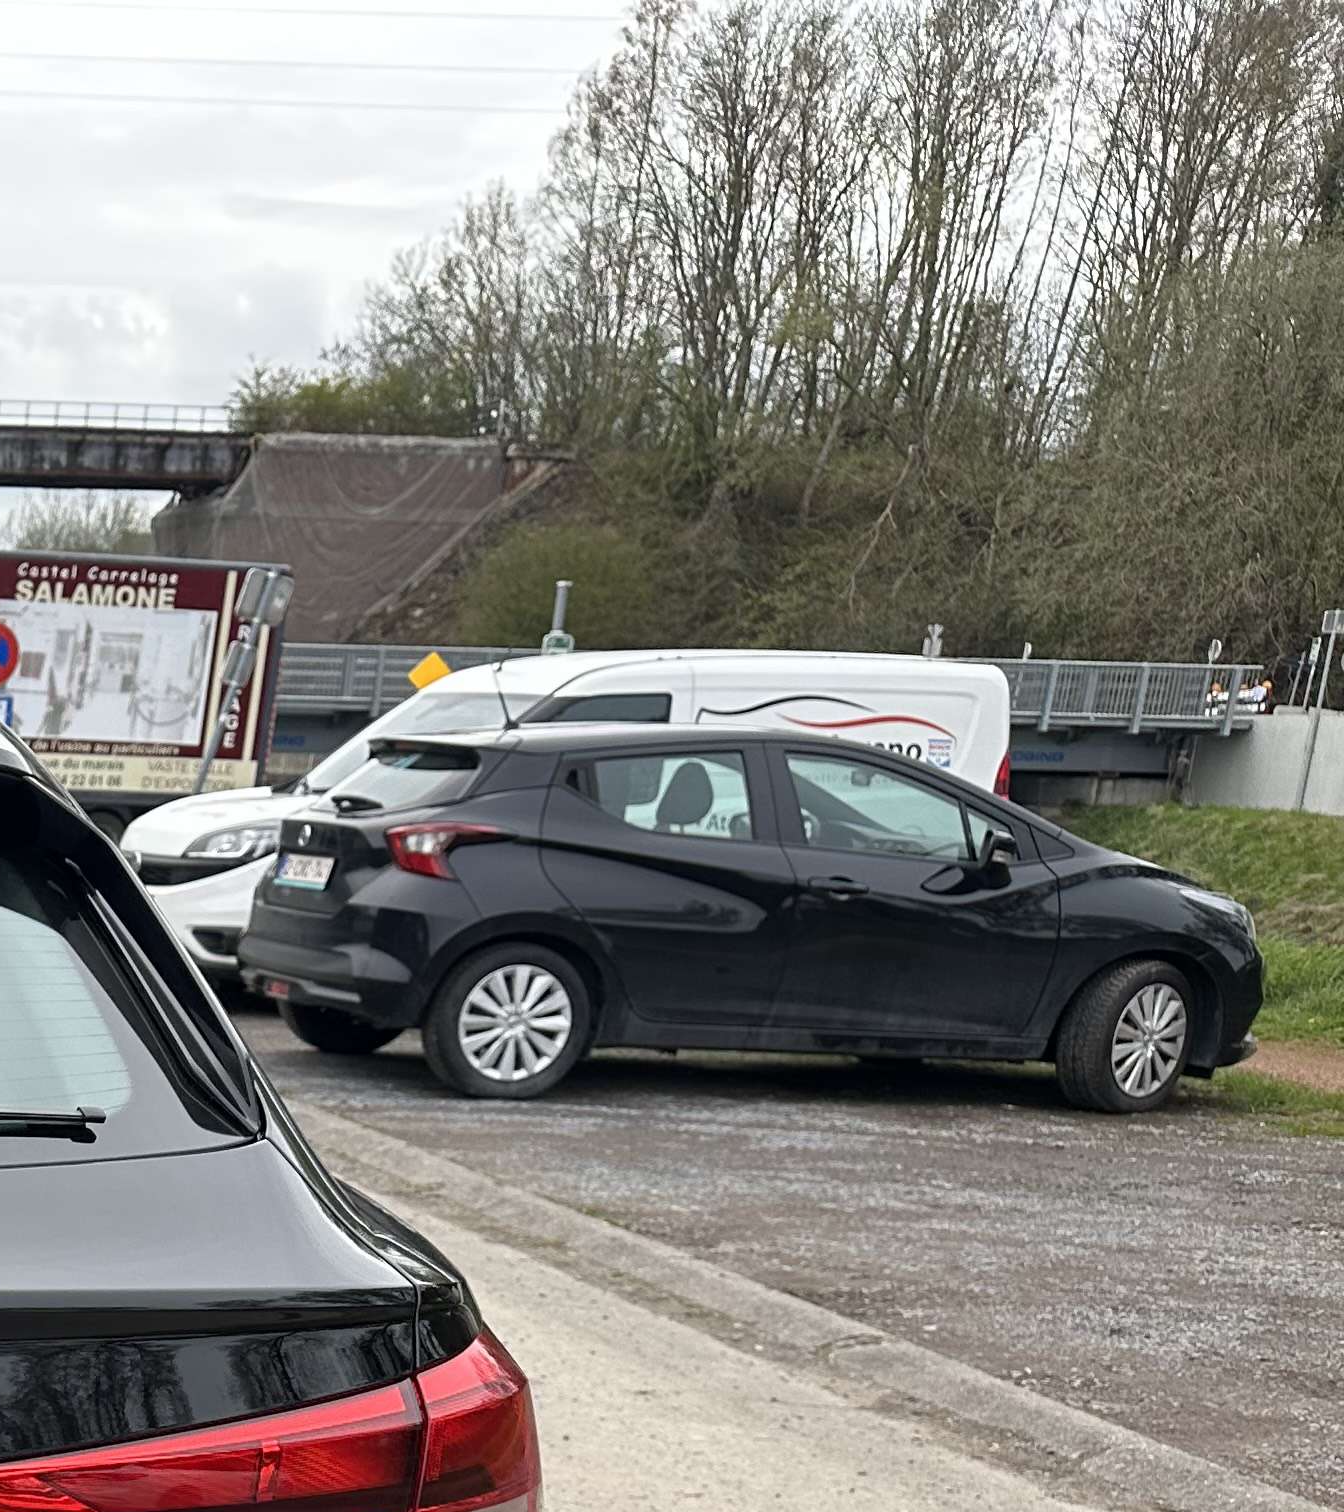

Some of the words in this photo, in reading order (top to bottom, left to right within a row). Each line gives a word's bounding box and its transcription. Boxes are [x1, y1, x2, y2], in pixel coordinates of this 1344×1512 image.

[17, 561, 79, 580] Castel
[87, 565, 180, 587] Carrelage
[14, 579, 178, 611] SALAMONE
